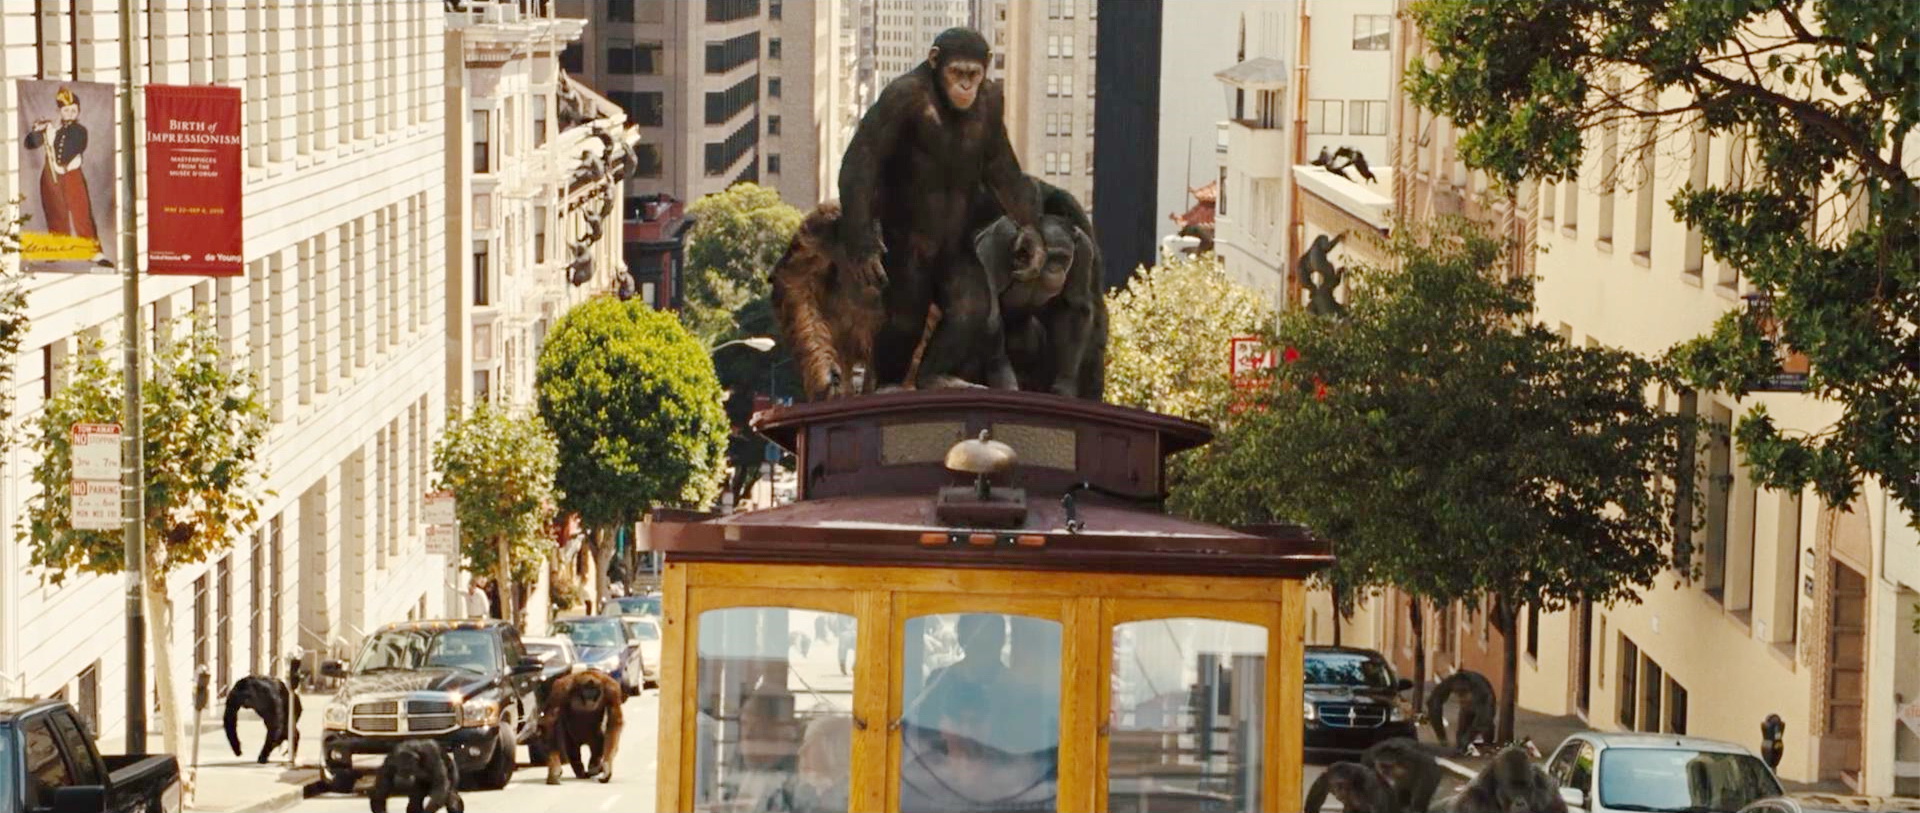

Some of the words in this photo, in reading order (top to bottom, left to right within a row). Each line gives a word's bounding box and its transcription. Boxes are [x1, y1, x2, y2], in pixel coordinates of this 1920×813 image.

[169, 120, 205, 131] BIRTH
[207, 122, 218, 133] of
[147, 131, 240, 145] IMPRESSIONISM
[204, 253, 216, 262] de
[216, 254, 241, 264] Young
[74, 433, 87, 445] NO
[73, 482, 87, 495] NO
[89, 484, 118, 495] PARKING
